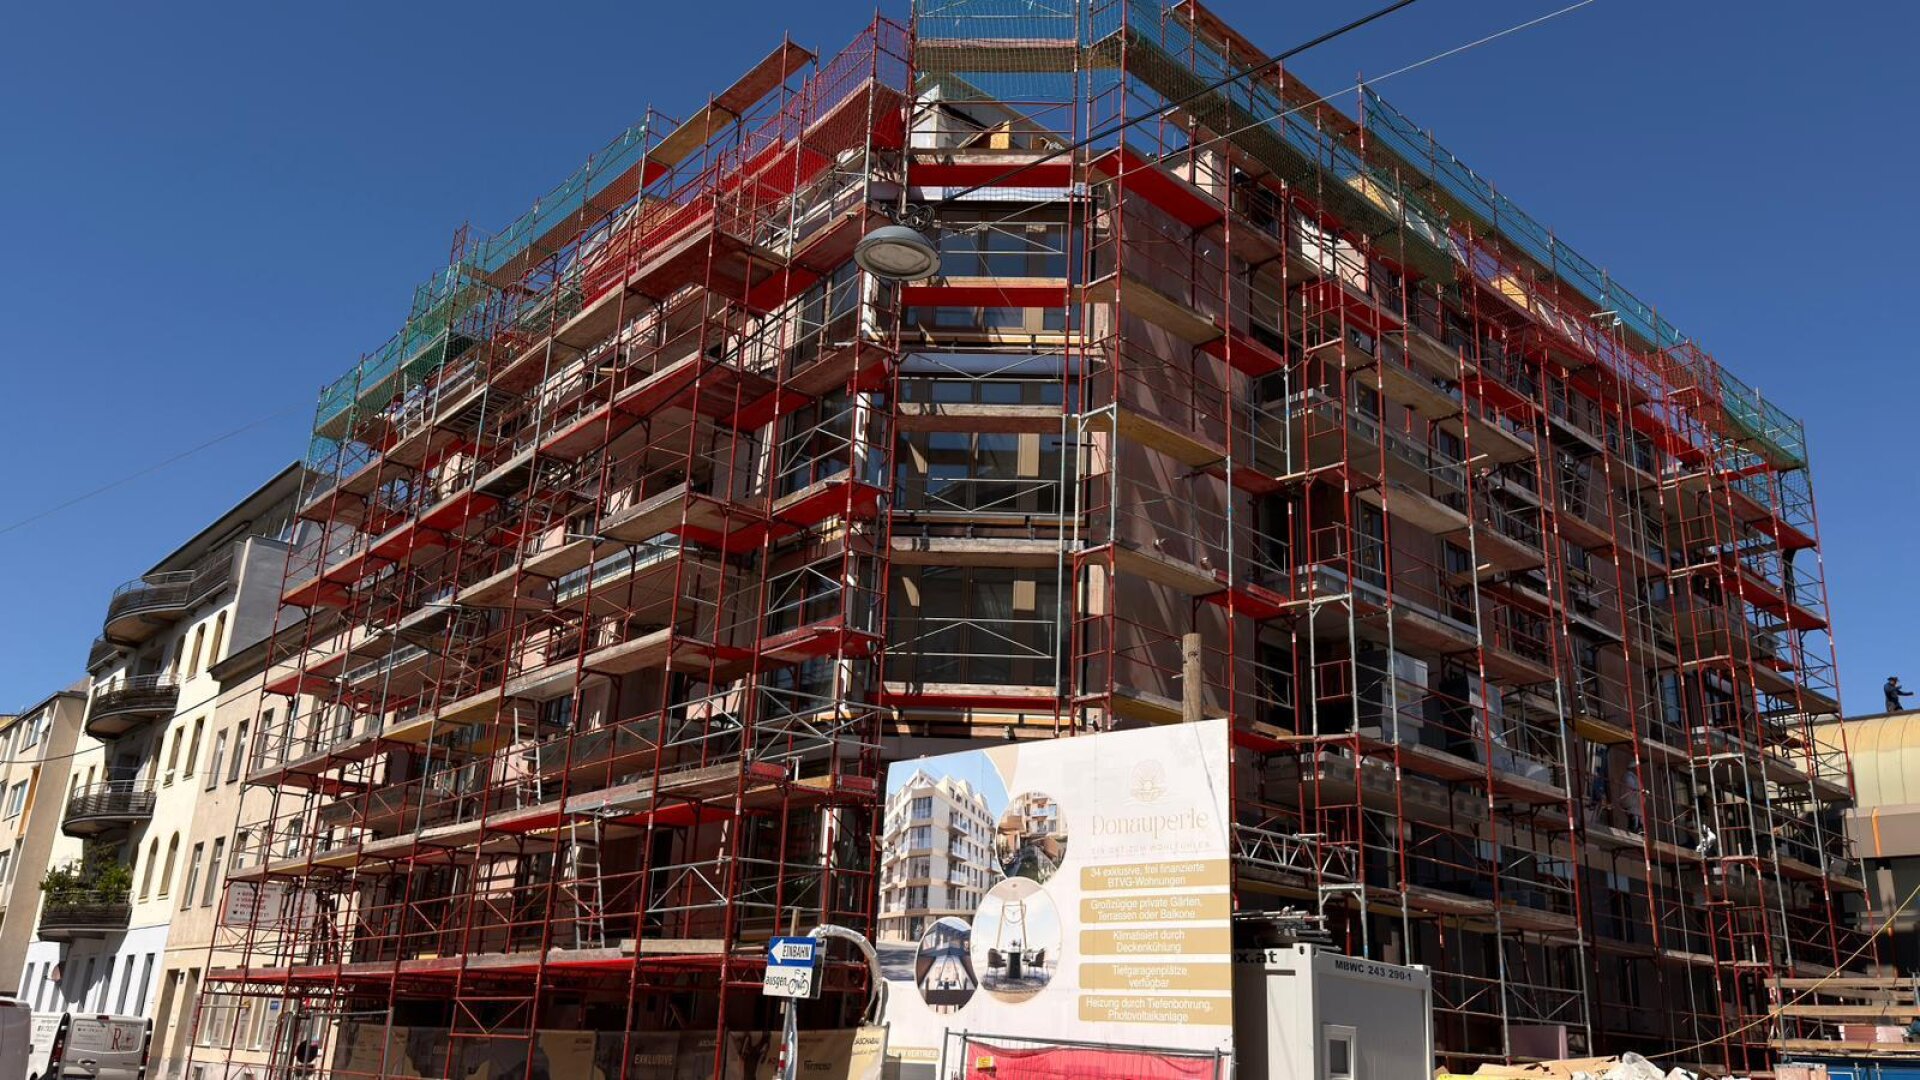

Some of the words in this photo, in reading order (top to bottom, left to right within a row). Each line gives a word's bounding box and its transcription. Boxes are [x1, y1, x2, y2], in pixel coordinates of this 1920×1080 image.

[1091, 806, 1209, 839] Donauperle
[1103, 866, 1143, 877] exklusive,
[1158, 863, 1205, 874] finanzierte
[1107, 876, 1186, 888] BTVG-Wohnungen
[1139, 897, 1168, 910] private
[1098, 910, 1137, 921] Terrassen
[1140, 910, 1158, 920] oder
[1161, 908, 1196, 920] Balkone
[1113, 930, 1158, 941] Klimatisiert
[1160, 930, 1185, 940] durch
[782, 945, 811, 957] EINBAHN
[1116, 941, 1182, 954] Deckenkühlung
[1234, 950, 1278, 964] x.at
[1113, 964, 1188, 978] Tiefgaragenplätze
[1334, 959, 1364, 974] MBWC
[1128, 977, 1170, 989] verfügbar
[1086, 997, 1120, 1009] Heizung
[1121, 997, 1146, 1009] durch
[1147, 998, 1213, 1012] Tiefenbohrung,
[1107, 1009, 1189, 1023] Photovoltaikanlage
[634, 1054, 673, 1066] EXKLUSIVE
